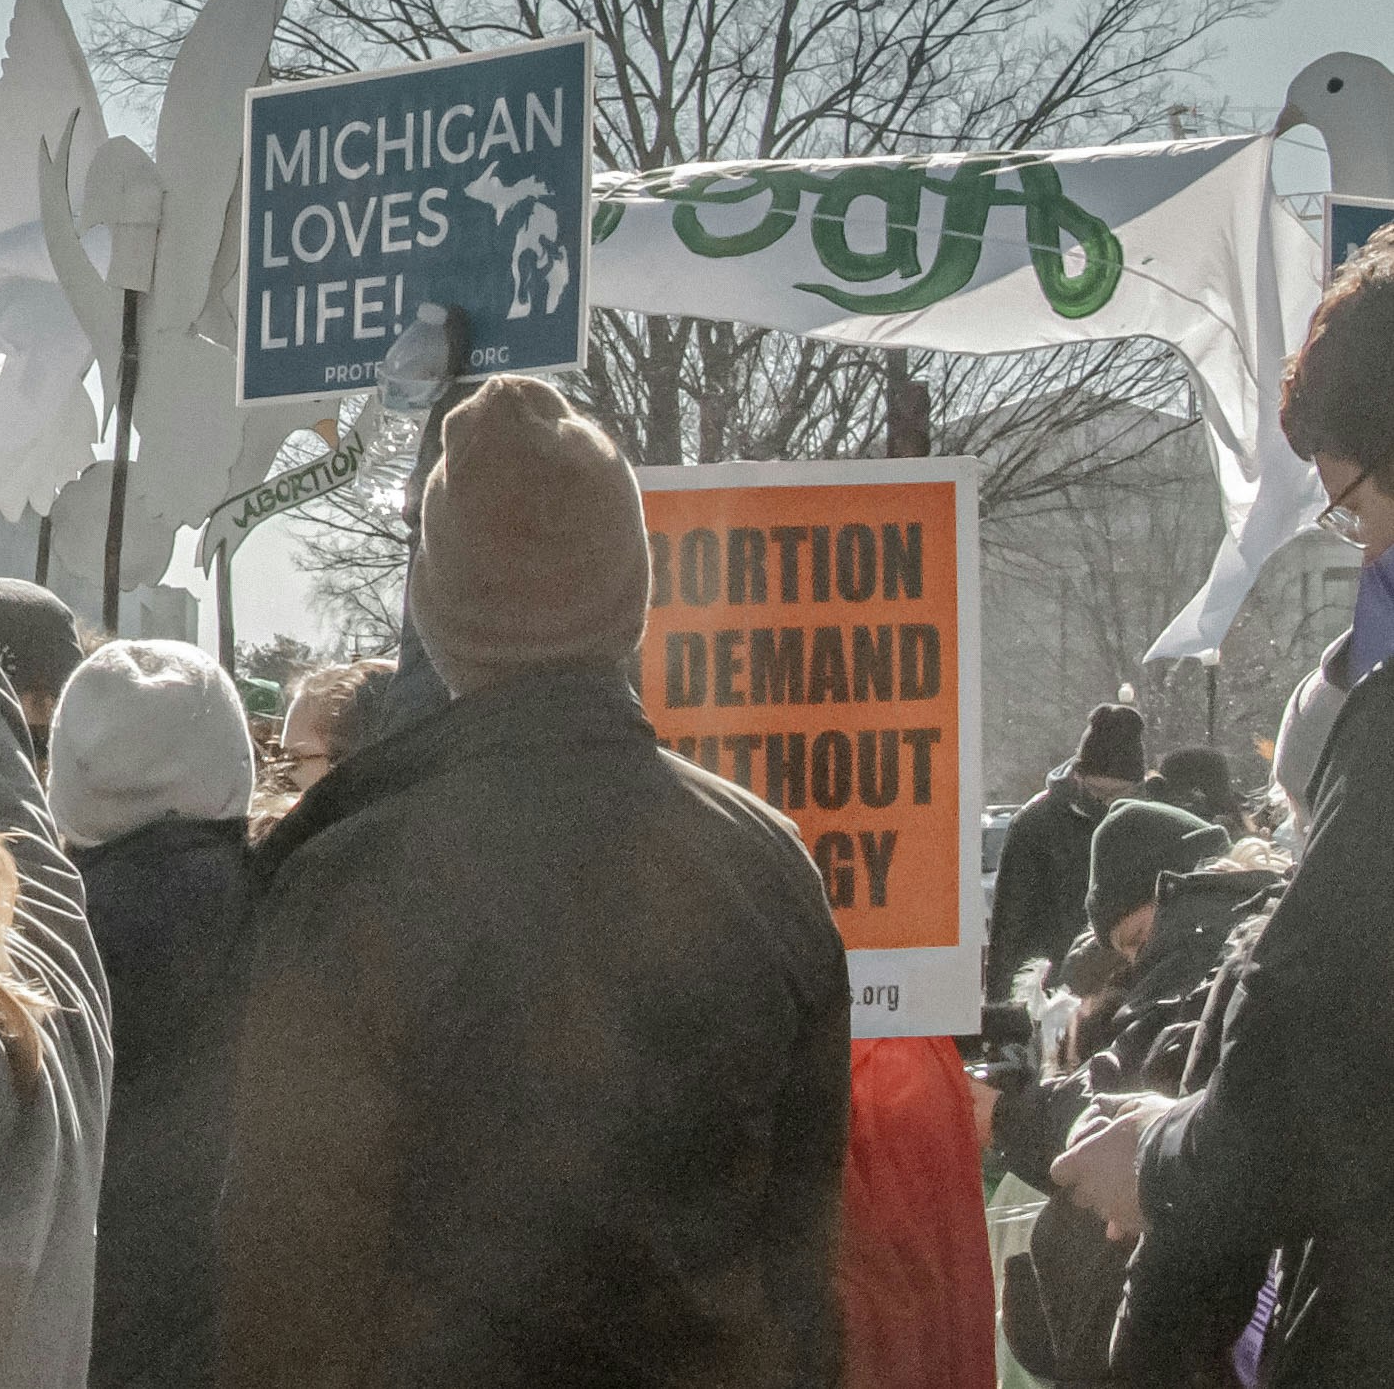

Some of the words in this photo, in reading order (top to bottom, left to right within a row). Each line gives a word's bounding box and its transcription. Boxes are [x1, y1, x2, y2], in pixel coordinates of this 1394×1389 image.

[265, 88, 563, 191] MICHIGAN
[262, 188, 449, 268] LOVES
[260, 273, 406, 350] LIFE!
[232, 431, 364, 528] ABORTION
[665, 623, 941, 709] DEMAND
